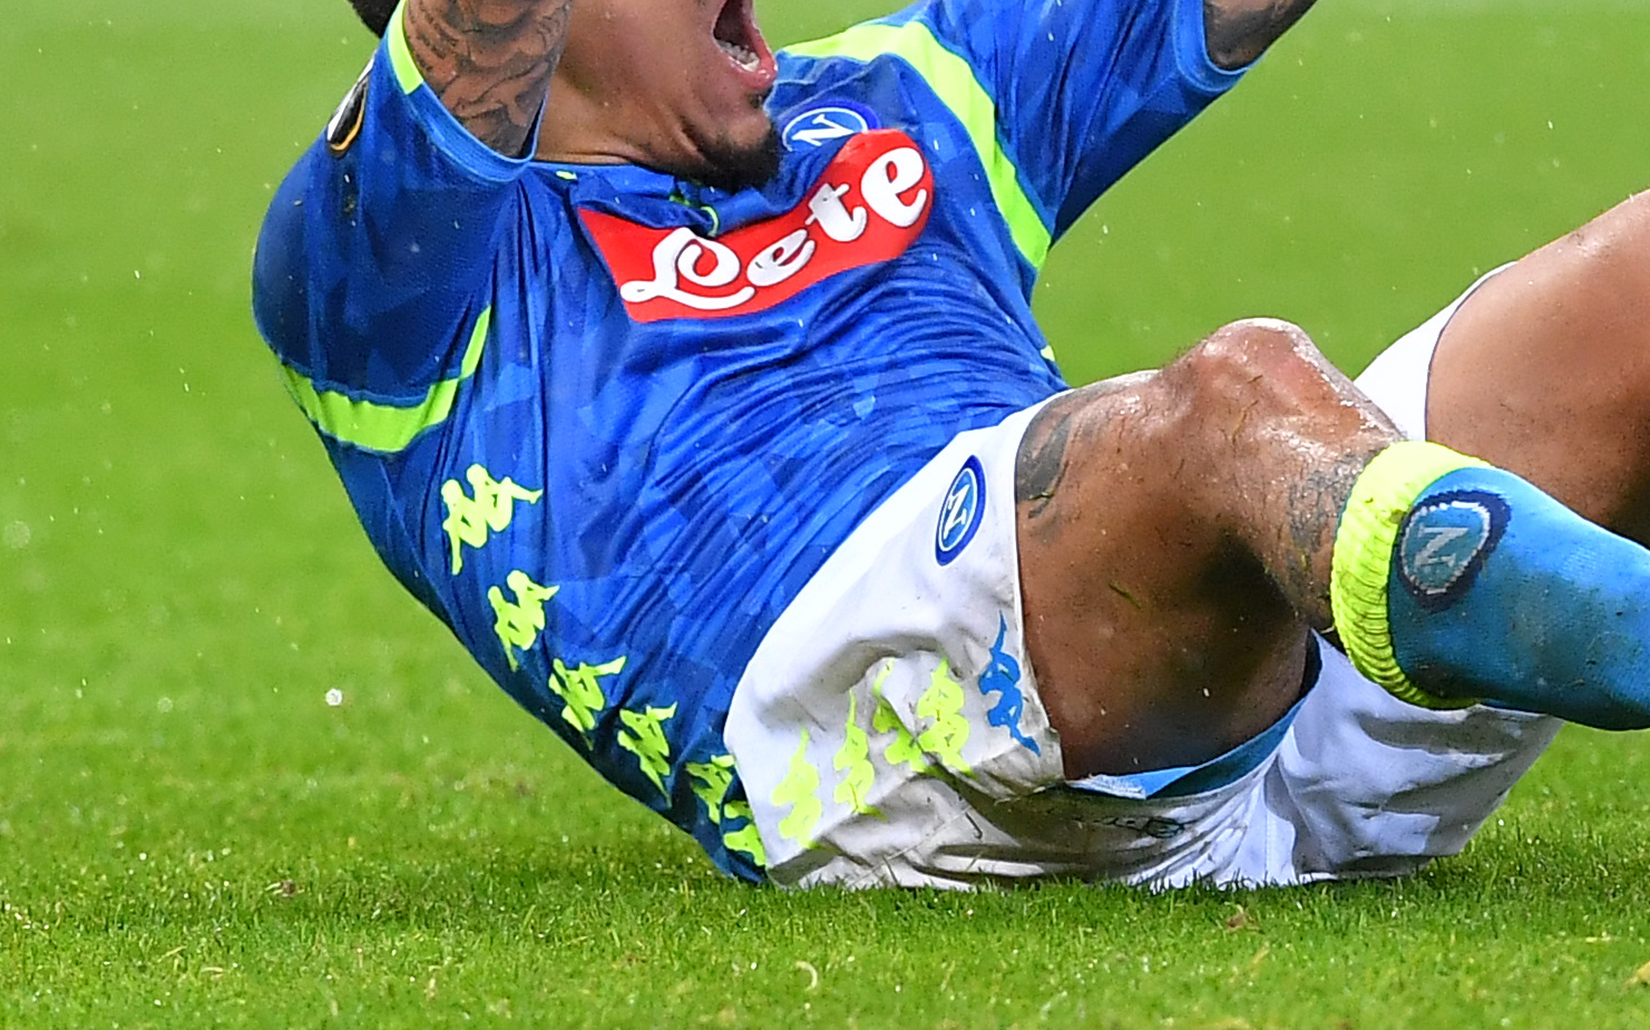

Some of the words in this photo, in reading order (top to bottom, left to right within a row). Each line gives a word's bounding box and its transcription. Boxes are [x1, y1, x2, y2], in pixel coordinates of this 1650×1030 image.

[791, 113, 855, 147] N
[619, 146, 928, 311] Lete
[942, 483, 971, 541] N
[1414, 523, 1470, 573] N
